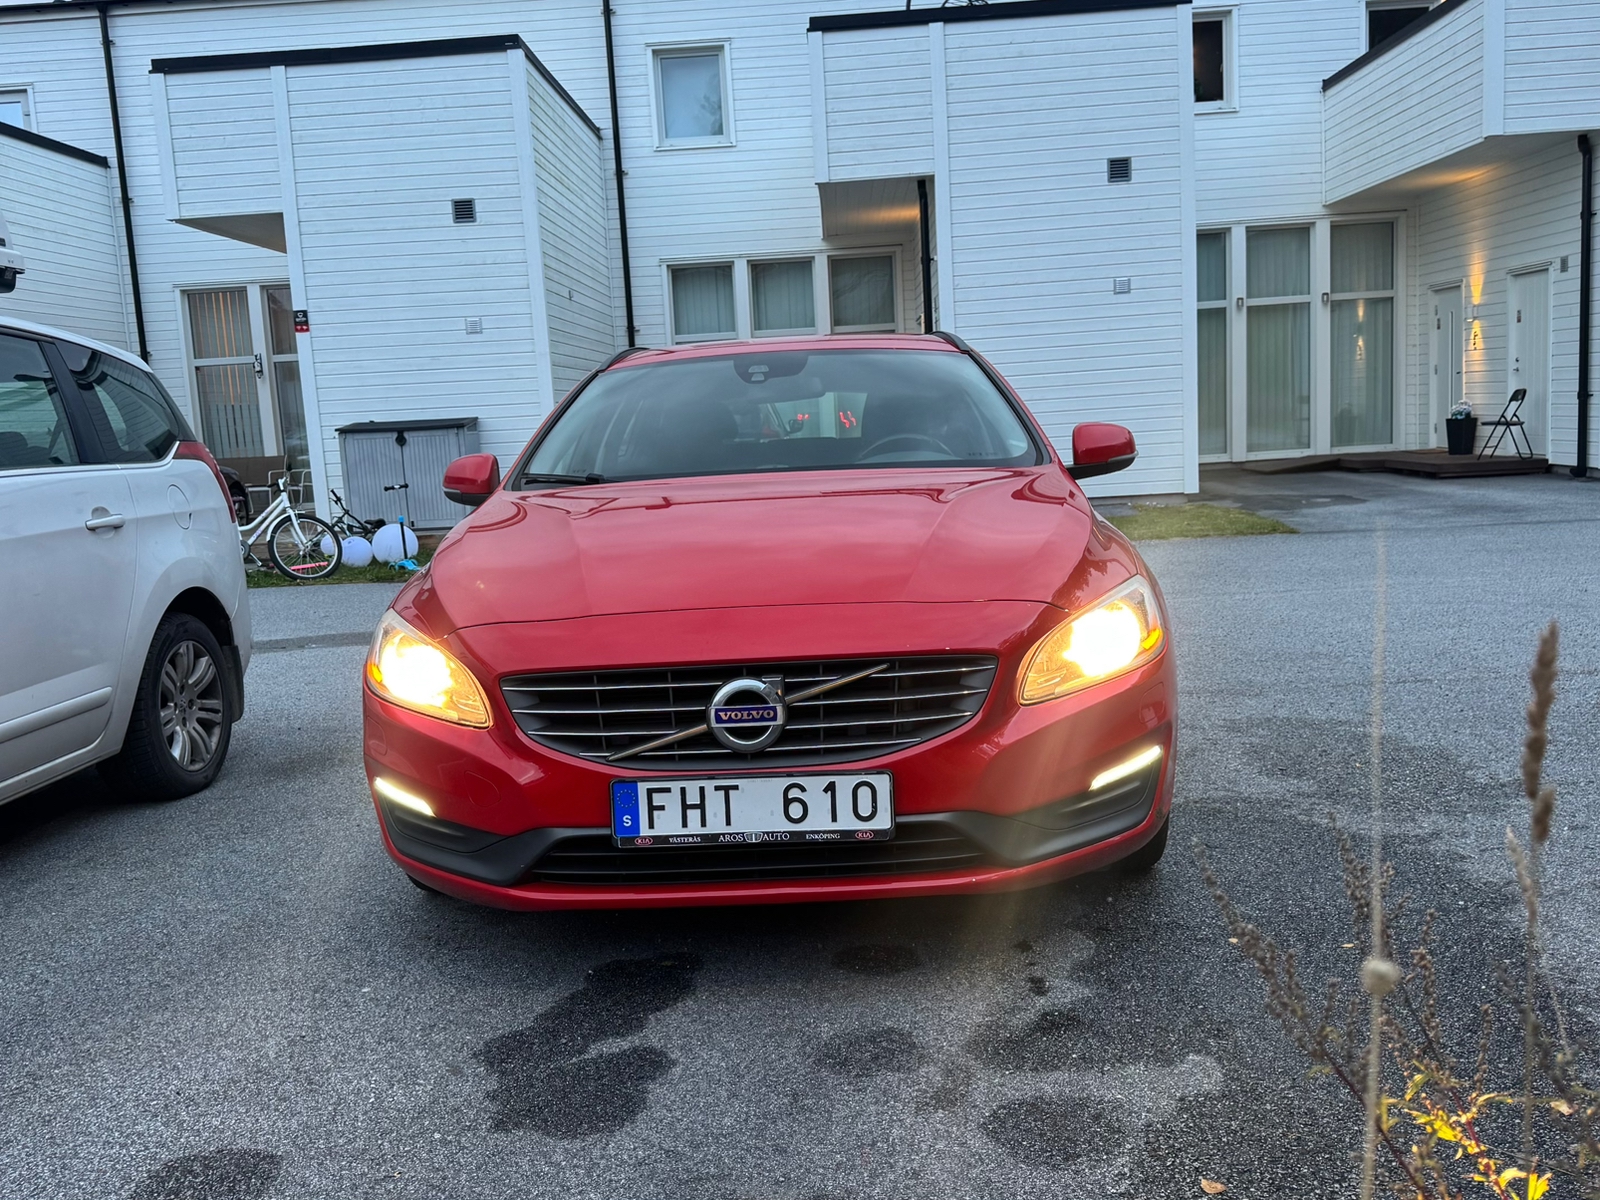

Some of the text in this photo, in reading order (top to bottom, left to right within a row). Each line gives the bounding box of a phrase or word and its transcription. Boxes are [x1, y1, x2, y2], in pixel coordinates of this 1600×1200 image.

[718, 709, 774, 720] VOLVO
[646, 780, 877, 829] FHT 610
[622, 814, 632, 827] S
[637, 837, 652, 845] KIA
[718, 833, 744, 843] AROS
[762, 832, 790, 841] AUTO
[857, 830, 872, 839] KIA
